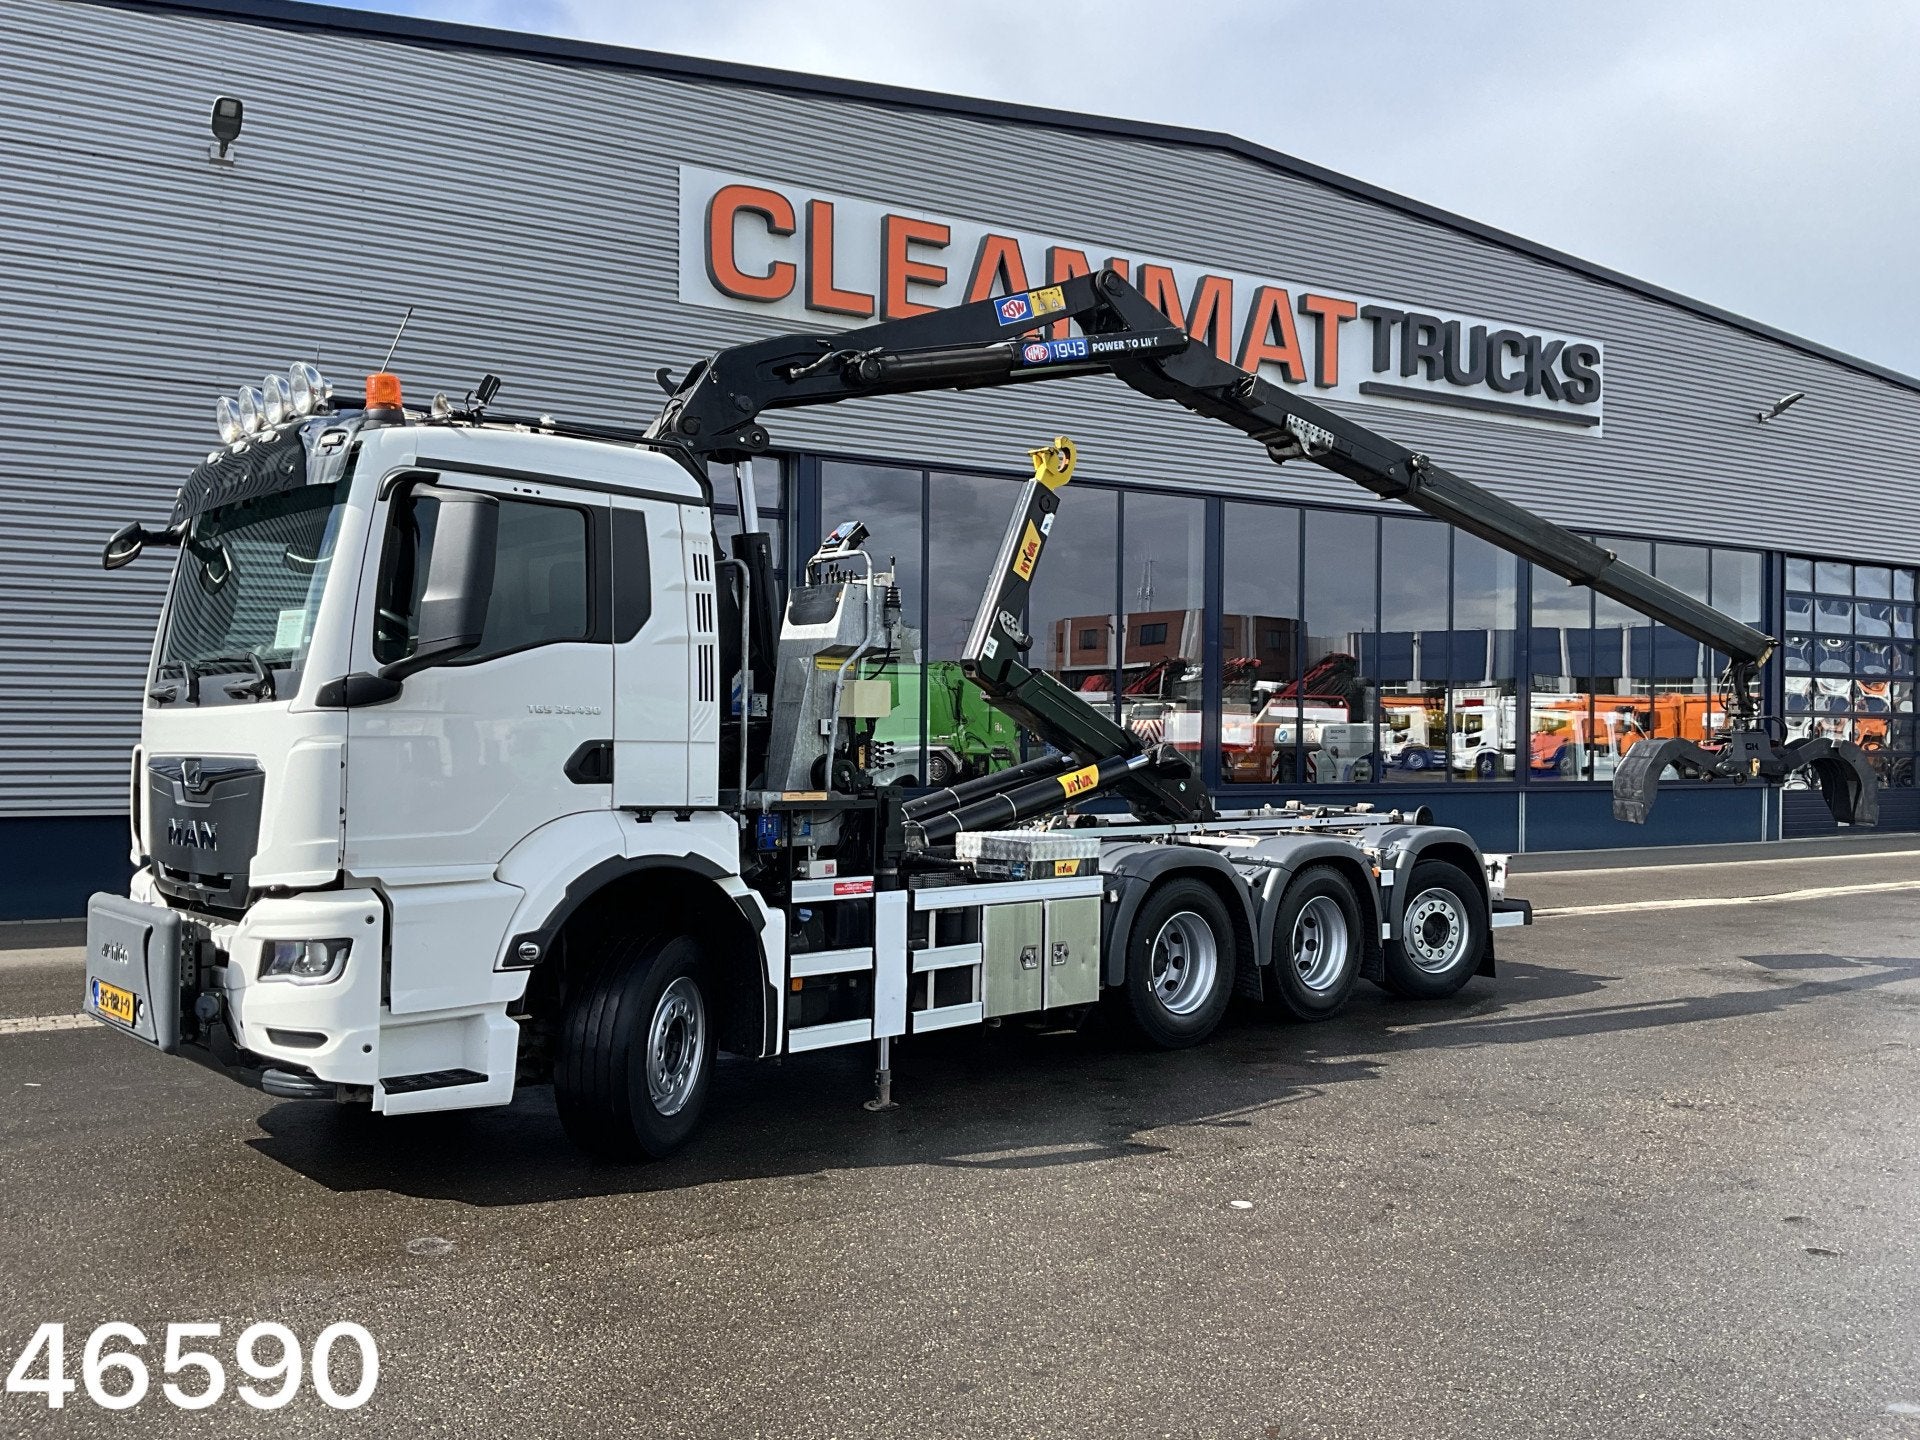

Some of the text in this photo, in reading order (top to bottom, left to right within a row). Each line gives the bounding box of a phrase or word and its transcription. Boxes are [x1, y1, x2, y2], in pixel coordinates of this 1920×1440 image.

[1003, 300, 1025, 318] HSW
[1026, 346, 1047, 361] HMF
[1054, 342, 1086, 358] 1943
[1092, 341, 1124, 352] POWER
[1126, 338, 1139, 348] TO
[1360, 305, 1600, 404] TRUCKS
[1020, 541, 1038, 574] HYVA
[527, 705, 552, 714] TGS
[1066, 775, 1093, 793] HYVA
[168, 818, 217, 851] MAN
[1057, 863, 1073, 874] HYVA
